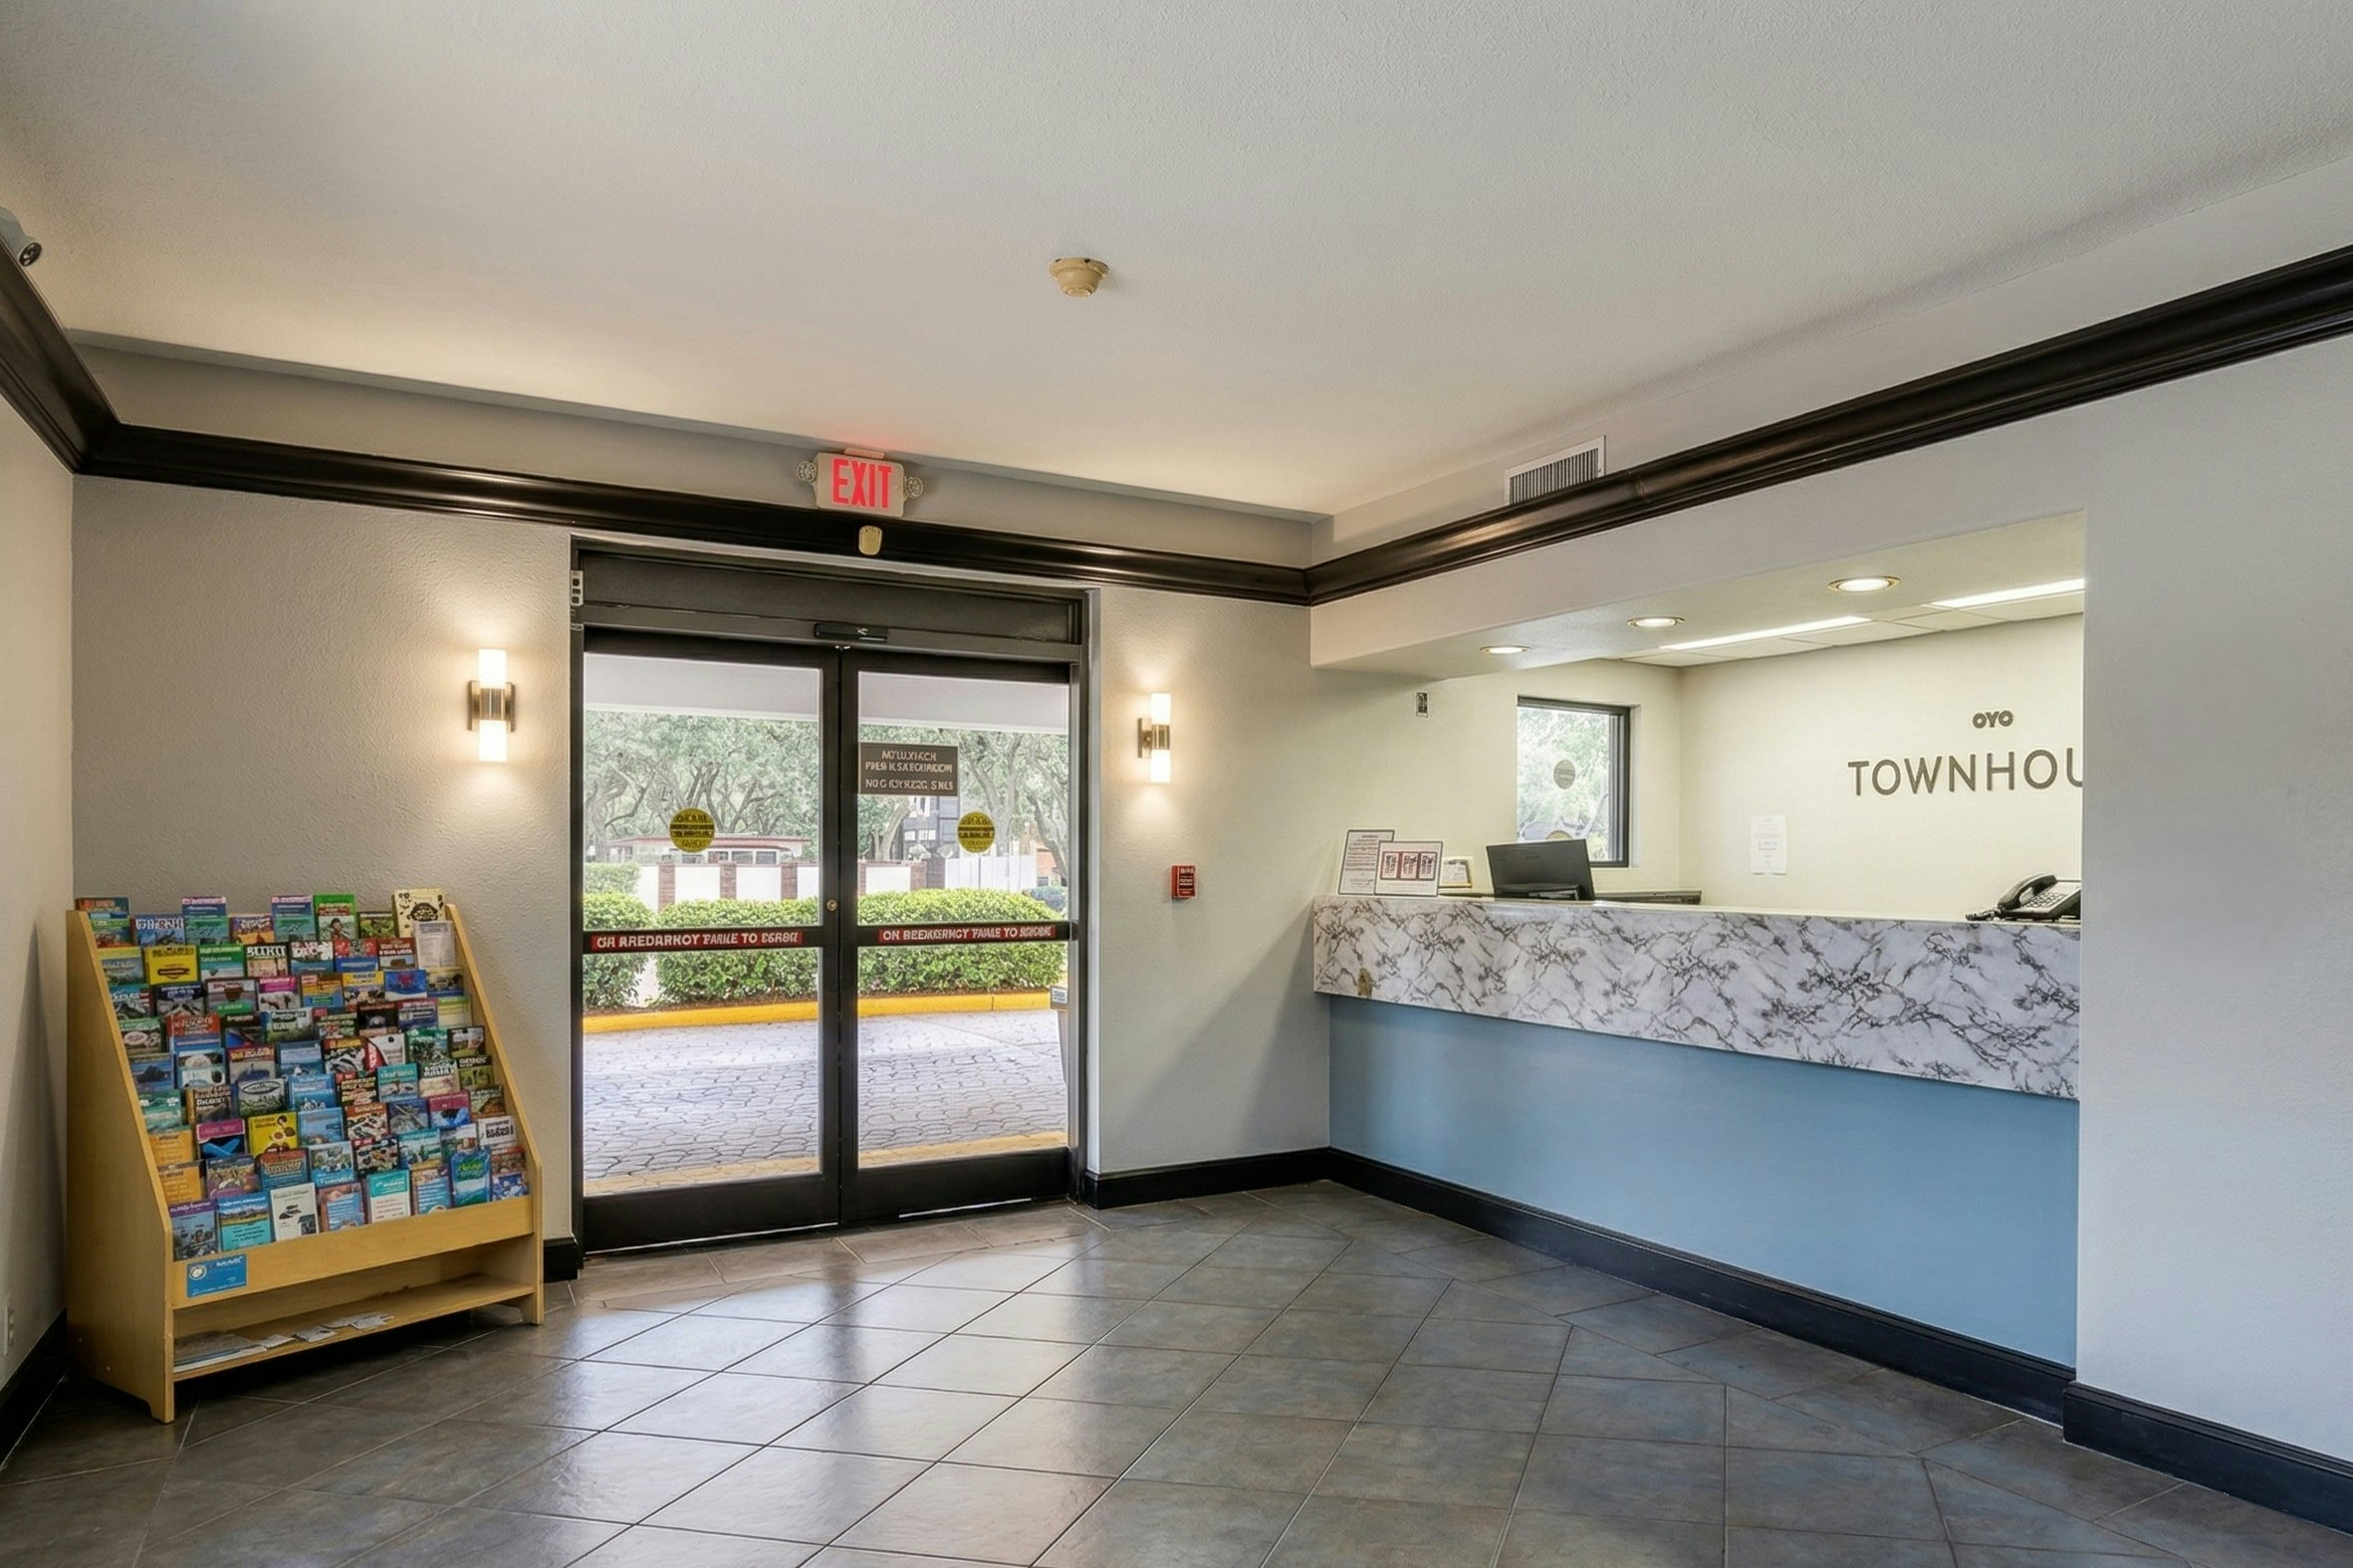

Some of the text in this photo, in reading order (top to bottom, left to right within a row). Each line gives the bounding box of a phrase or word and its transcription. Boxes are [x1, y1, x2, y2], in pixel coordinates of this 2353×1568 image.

[832, 458, 892, 510] EXIT
[1972, 710, 2013, 729] OYO
[741, 932, 758, 944] TO
